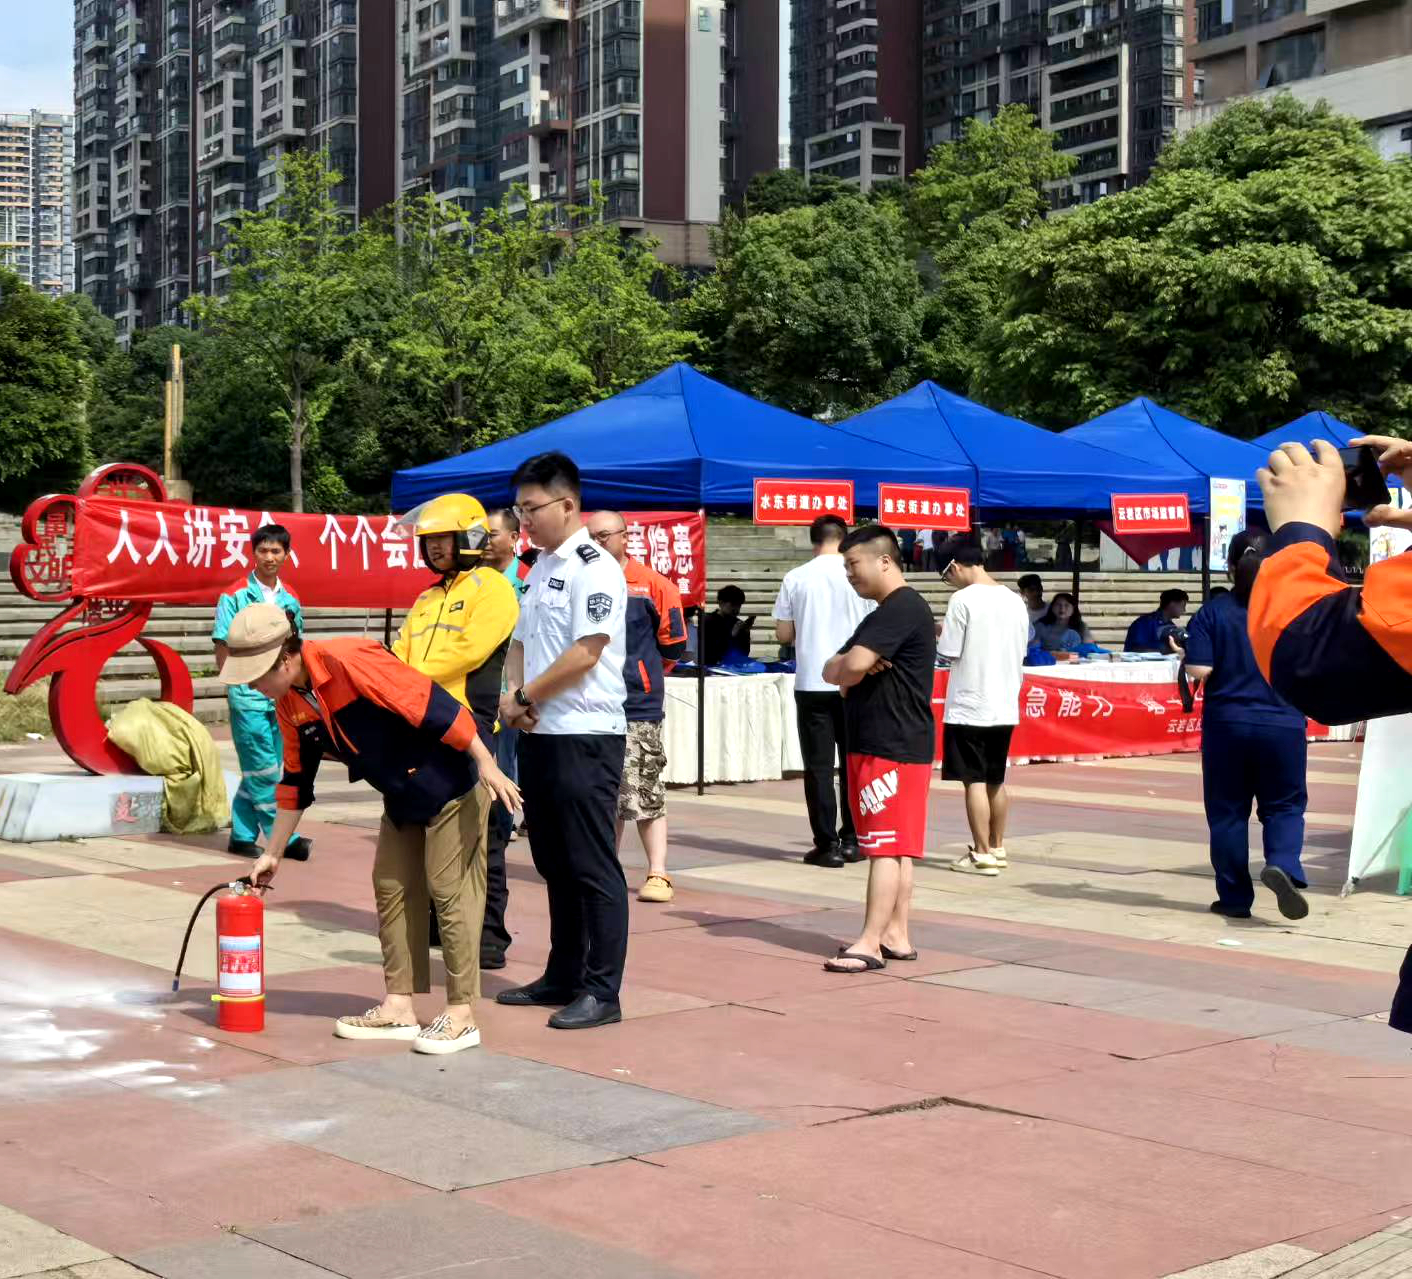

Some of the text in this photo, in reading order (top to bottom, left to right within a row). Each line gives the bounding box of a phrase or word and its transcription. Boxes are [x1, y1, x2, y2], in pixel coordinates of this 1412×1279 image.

[760, 493, 848, 511] 水东街道办事处
